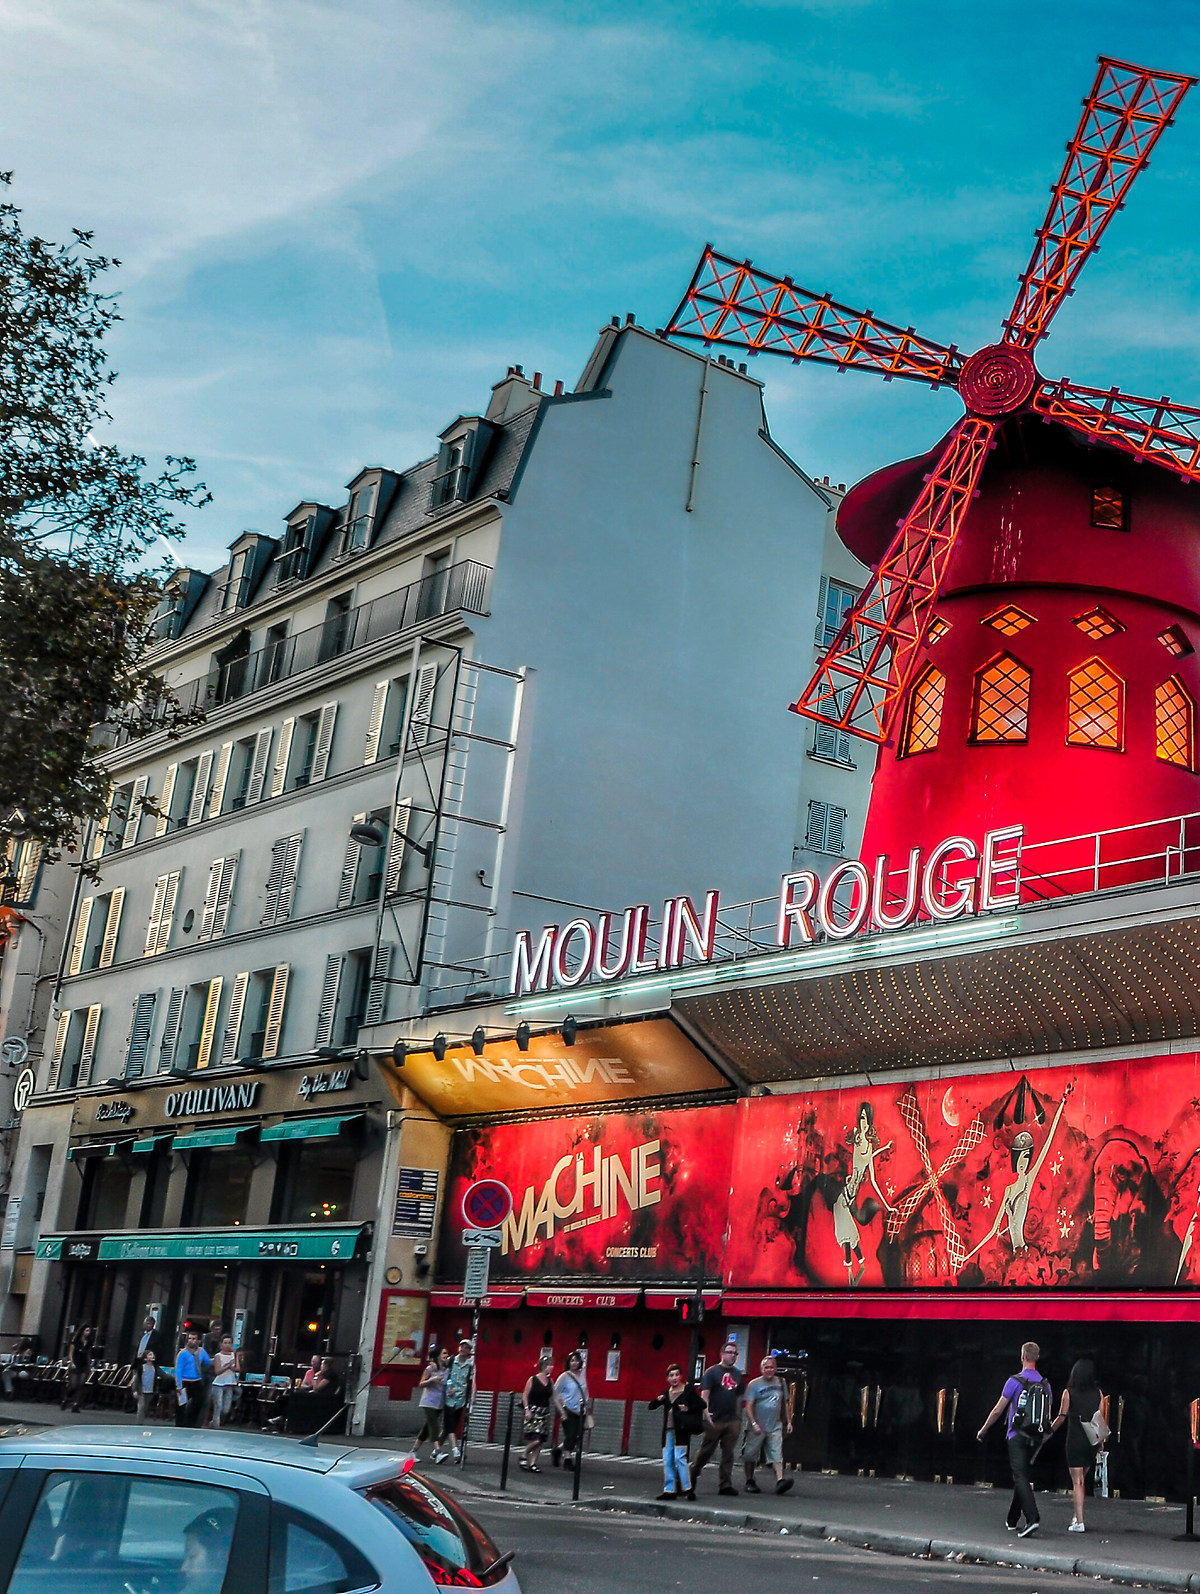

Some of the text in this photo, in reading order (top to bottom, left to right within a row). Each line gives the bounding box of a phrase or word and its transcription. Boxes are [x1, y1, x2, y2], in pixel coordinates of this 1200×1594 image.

[508, 823, 1025, 997] MOULIN ROUGE
[164, 1080, 260, 1118] O'SULLIVANS
[500, 1138, 662, 1256] MACHINE
[605, 1246, 658, 1258] CONCERTS CLUB
[546, 1295, 584, 1306] CONCERTS
[595, 1296, 616, 1307] CLUB
